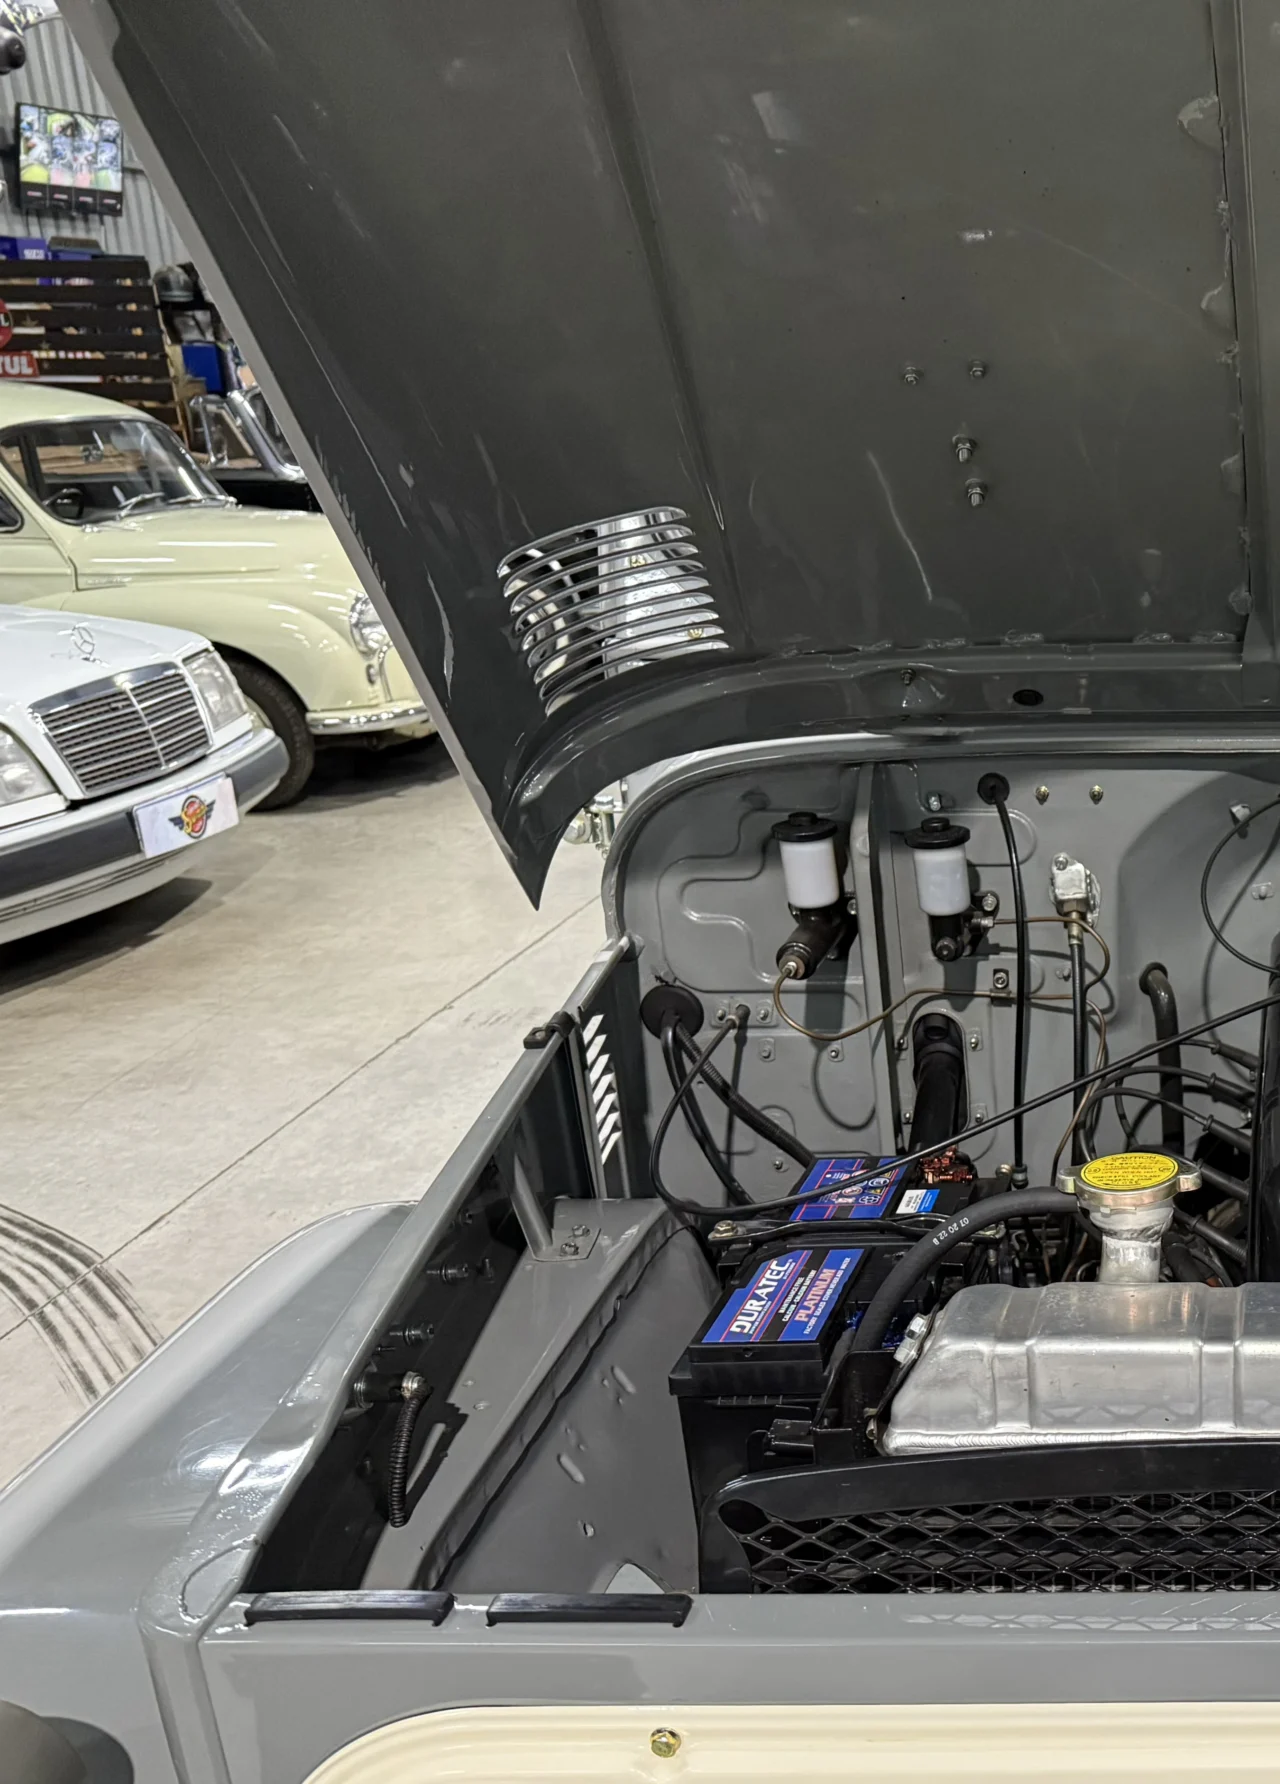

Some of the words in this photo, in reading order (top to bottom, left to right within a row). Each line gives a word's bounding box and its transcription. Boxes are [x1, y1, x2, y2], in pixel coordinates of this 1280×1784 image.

[948, 1222, 959, 1234] 20
[960, 1217, 969, 1227] 07
[793, 1277, 804, 1286] FREE
[802, 1269, 816, 1285] BATTERY
[729, 1260, 790, 1333] DURATEC
[794, 1268, 836, 1321] PLATINUM
